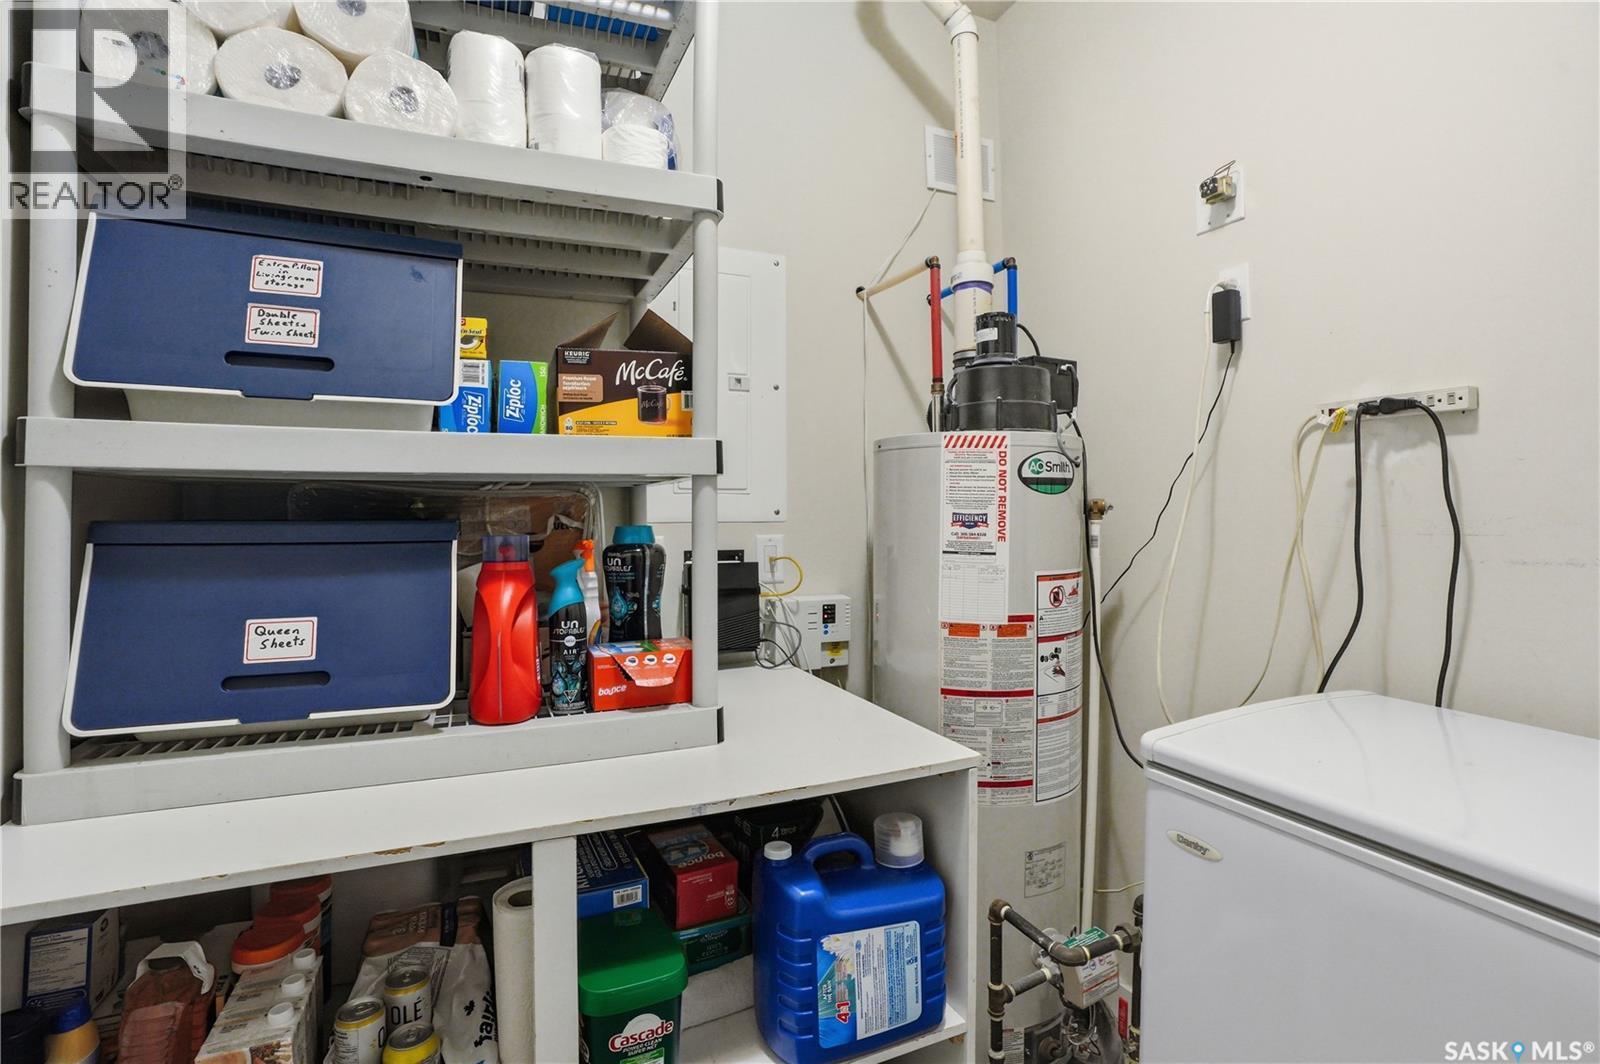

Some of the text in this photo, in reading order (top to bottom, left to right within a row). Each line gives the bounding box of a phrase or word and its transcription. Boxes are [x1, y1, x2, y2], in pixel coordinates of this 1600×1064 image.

[258, 260, 290, 269] Extra
[257, 309, 298, 319] Double
[251, 327, 282, 335] Twin
[615, 358, 685, 387] McCafé
[505, 379, 524, 418] Ziploc
[998, 451, 1007, 542] DO NOT REMOVE
[254, 625, 300, 636] Queen
[561, 620, 579, 629] un
[259, 636, 306, 650] Sheets
[598, 684, 628, 697] bounce
[677, 850, 725, 868] bounce
[390, 998, 423, 1026] OLÉ
[608, 1020, 673, 1052] Cascade
